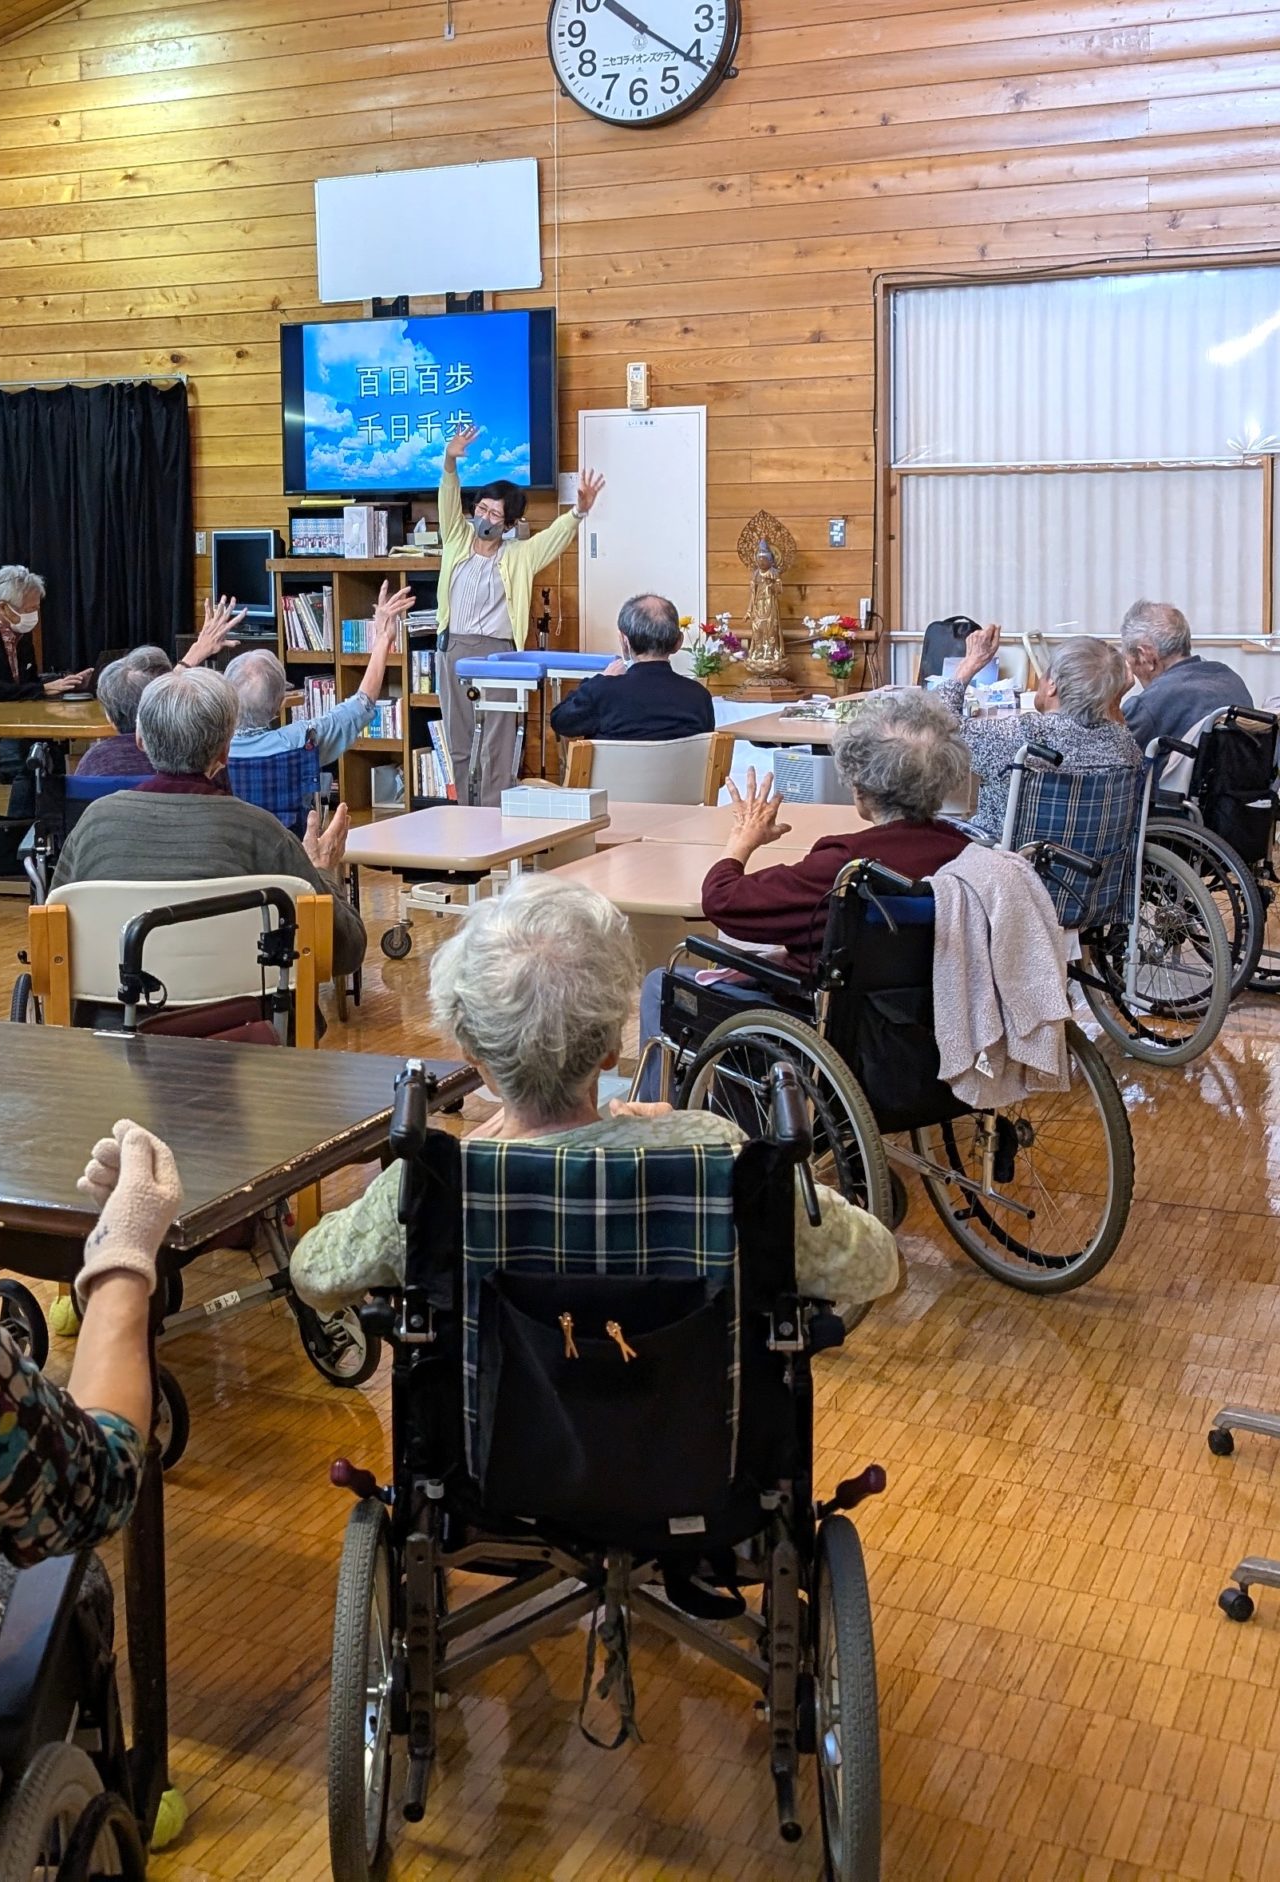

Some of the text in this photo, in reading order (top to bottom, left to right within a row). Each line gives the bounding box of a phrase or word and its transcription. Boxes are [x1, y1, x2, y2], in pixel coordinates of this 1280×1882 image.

[694, 4, 714, 33] 3
[567, 19, 587, 48] 9
[578, 49, 597, 77] 8
[683, 38, 705, 62] 4
[601, 74, 620, 101] 7
[628, 77, 648, 106] 6
[660, 66, 680, 94] 5
[356, 362, 473, 398] 百日百歩
